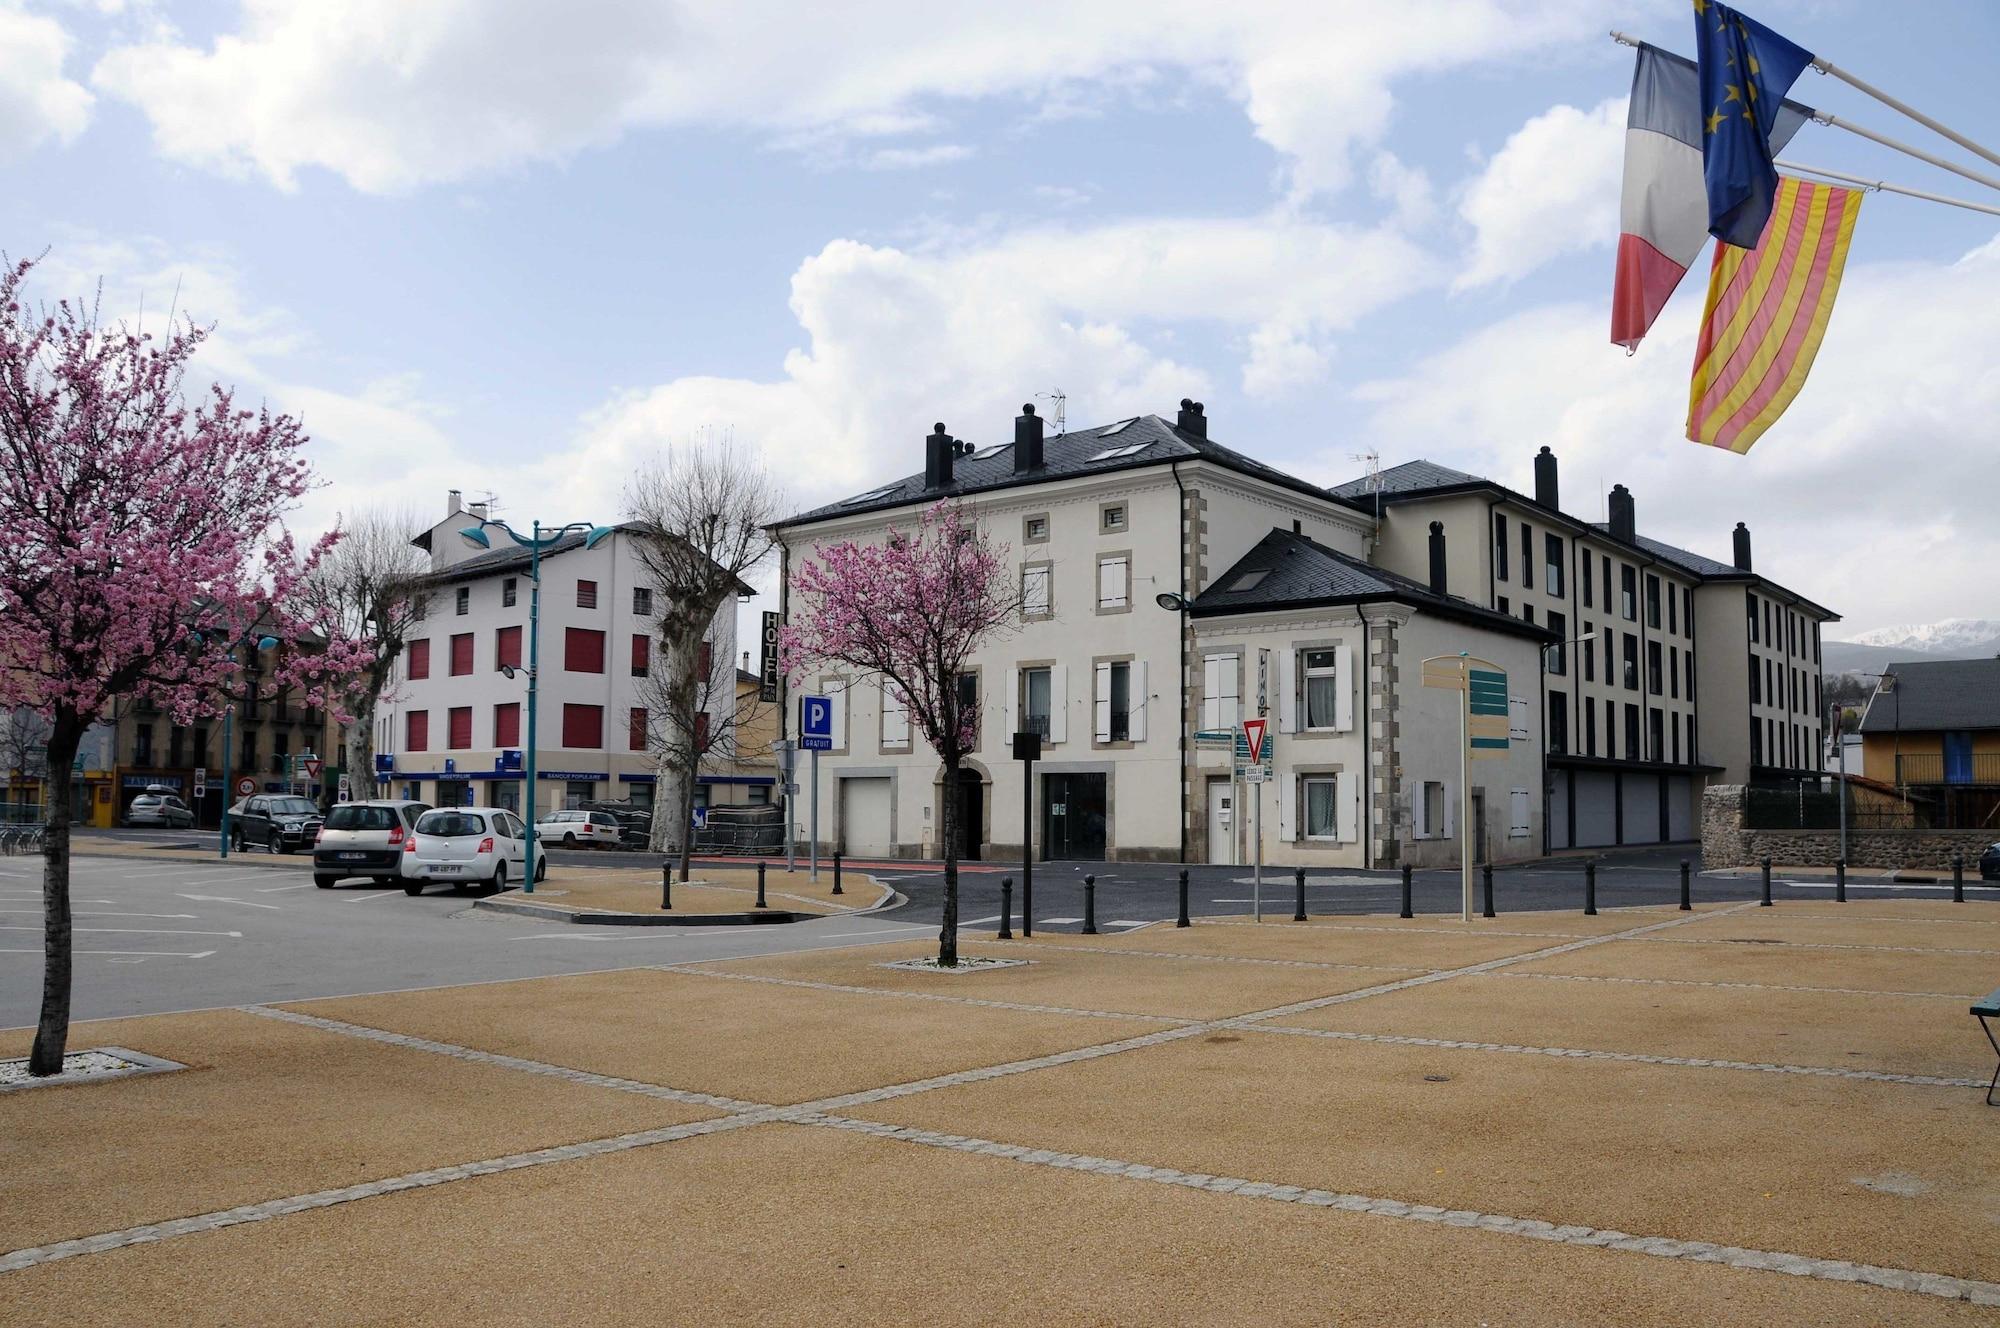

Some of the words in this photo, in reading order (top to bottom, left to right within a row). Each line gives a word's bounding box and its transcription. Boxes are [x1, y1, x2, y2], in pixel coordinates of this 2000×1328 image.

[764, 613, 778, 687] HOTEL
[811, 703, 824, 729] P
[805, 739, 830, 748] GRATUIT
